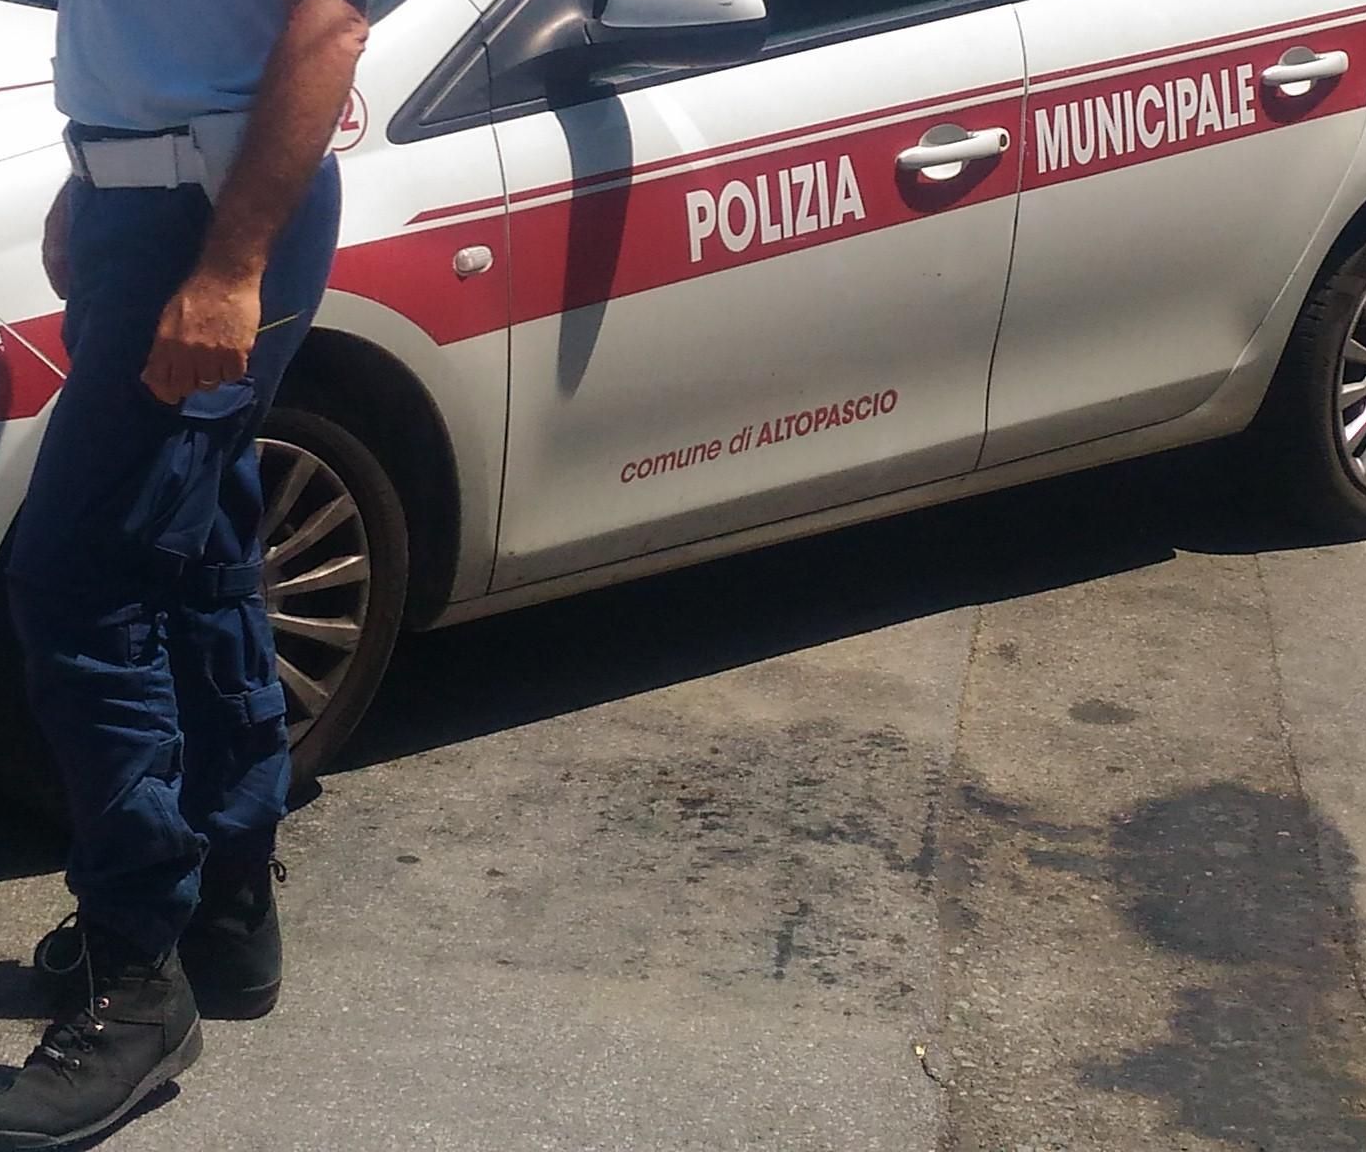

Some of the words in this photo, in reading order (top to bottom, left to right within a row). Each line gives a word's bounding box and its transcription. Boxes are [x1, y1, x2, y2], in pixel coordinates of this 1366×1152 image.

[685, 154, 867, 263] POLIZIA
[1034, 63, 1257, 174] MUNICIPALE
[620, 439, 723, 484] comune
[728, 425, 754, 455] di
[755, 389, 899, 448] ALTOPASCIO
